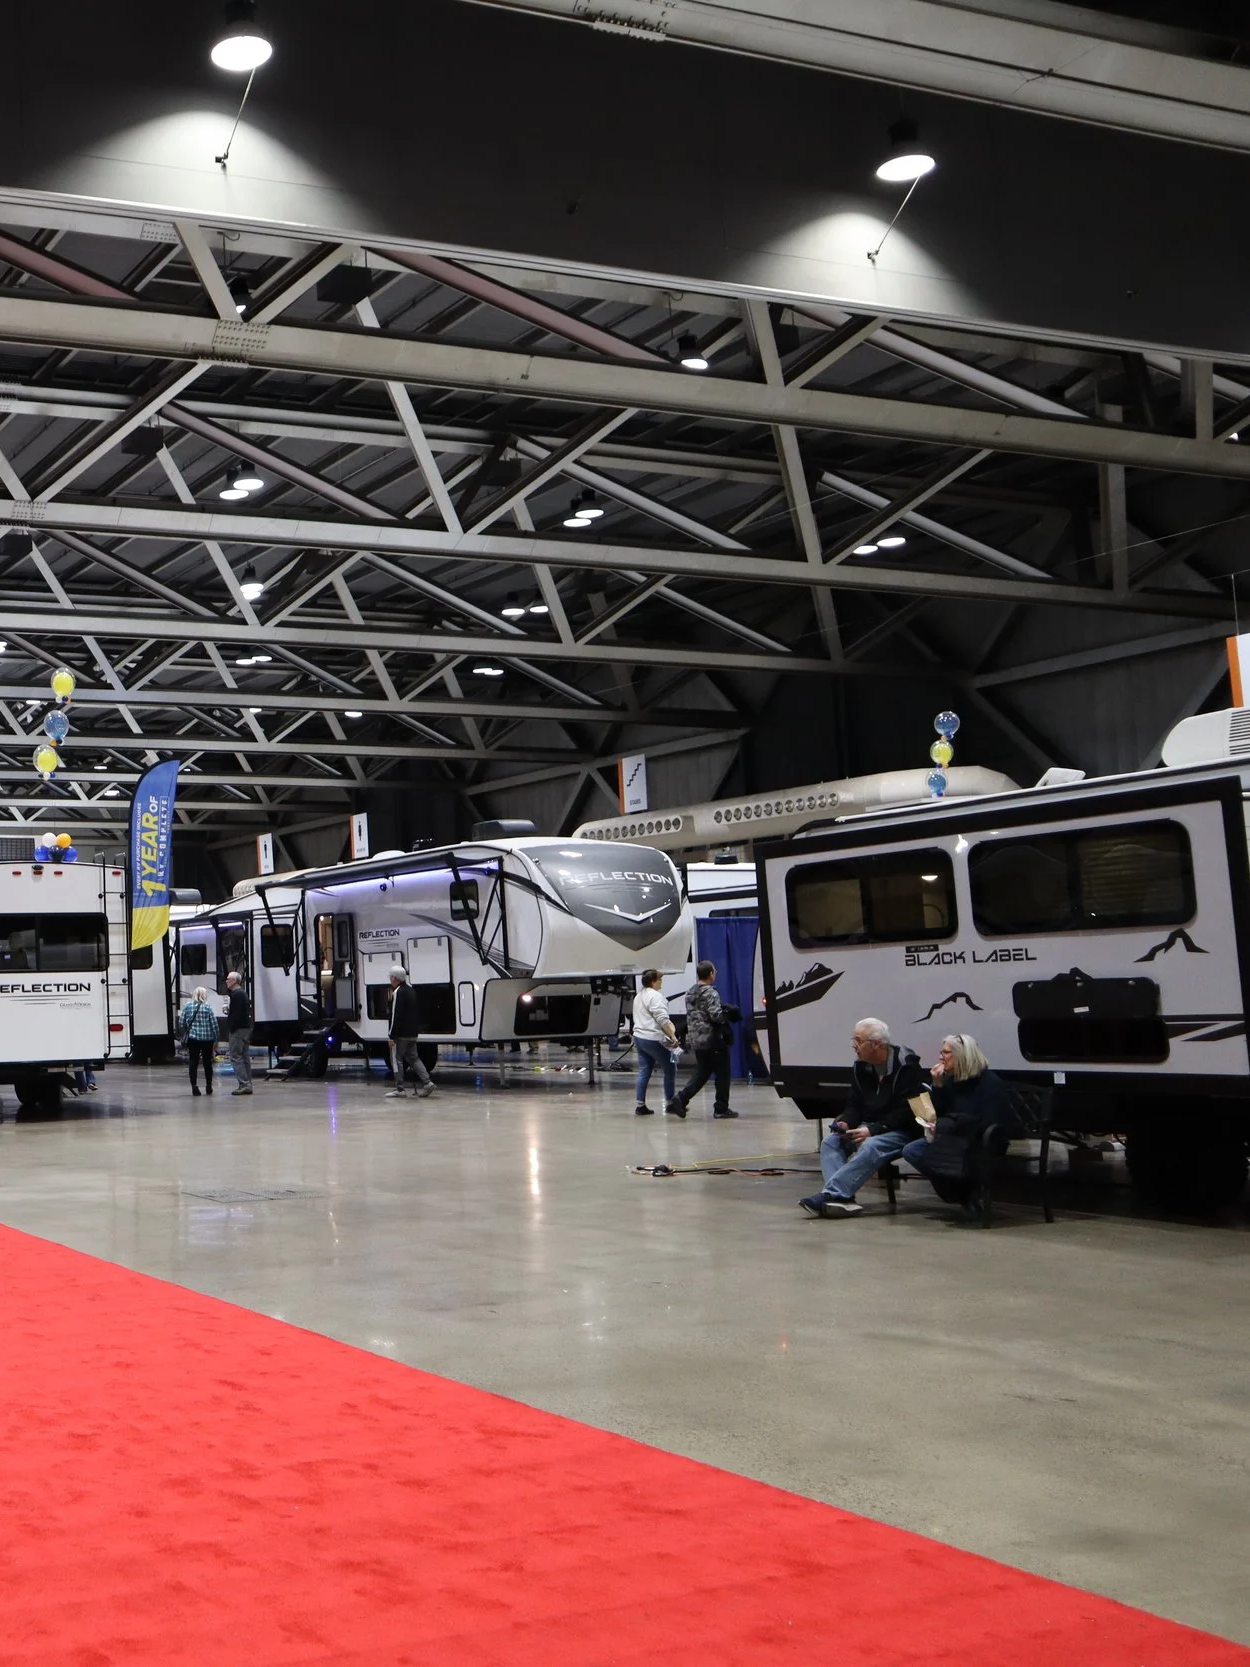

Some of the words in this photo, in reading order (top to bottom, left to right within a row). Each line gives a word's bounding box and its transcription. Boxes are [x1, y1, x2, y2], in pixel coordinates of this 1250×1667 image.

[149, 795, 159, 813] OF
[141, 812, 159, 876] YEAR
[559, 871, 673, 885] REFLECTION
[142, 879, 167, 896] 1
[359, 929, 400, 939] REFLECTION
[905, 951, 966, 967] BLACK
[972, 948, 1037, 964] LABEL
